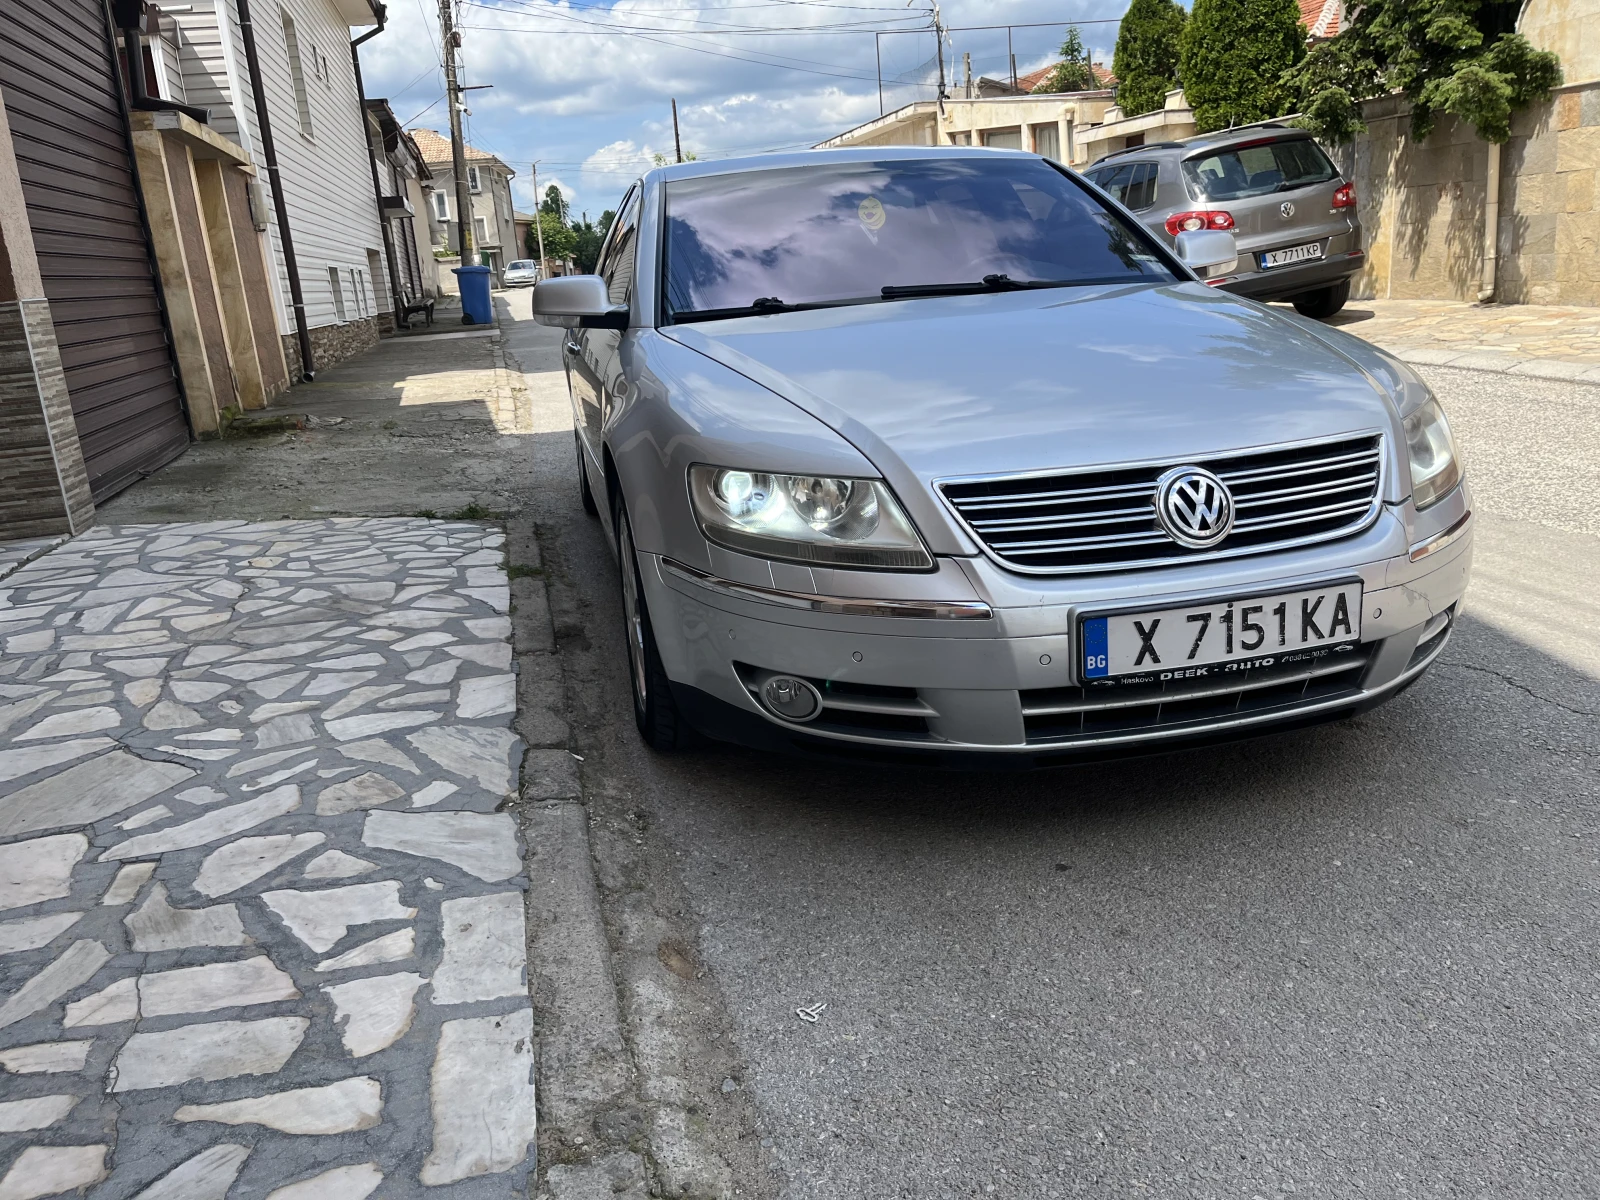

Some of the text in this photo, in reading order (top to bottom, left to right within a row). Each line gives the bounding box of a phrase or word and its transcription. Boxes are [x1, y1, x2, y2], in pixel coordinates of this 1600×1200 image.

[1271, 253, 1278, 264] X
[1168, 474, 1228, 537] VW
[1133, 618, 1161, 666] X
[1087, 655, 1106, 669] BG
